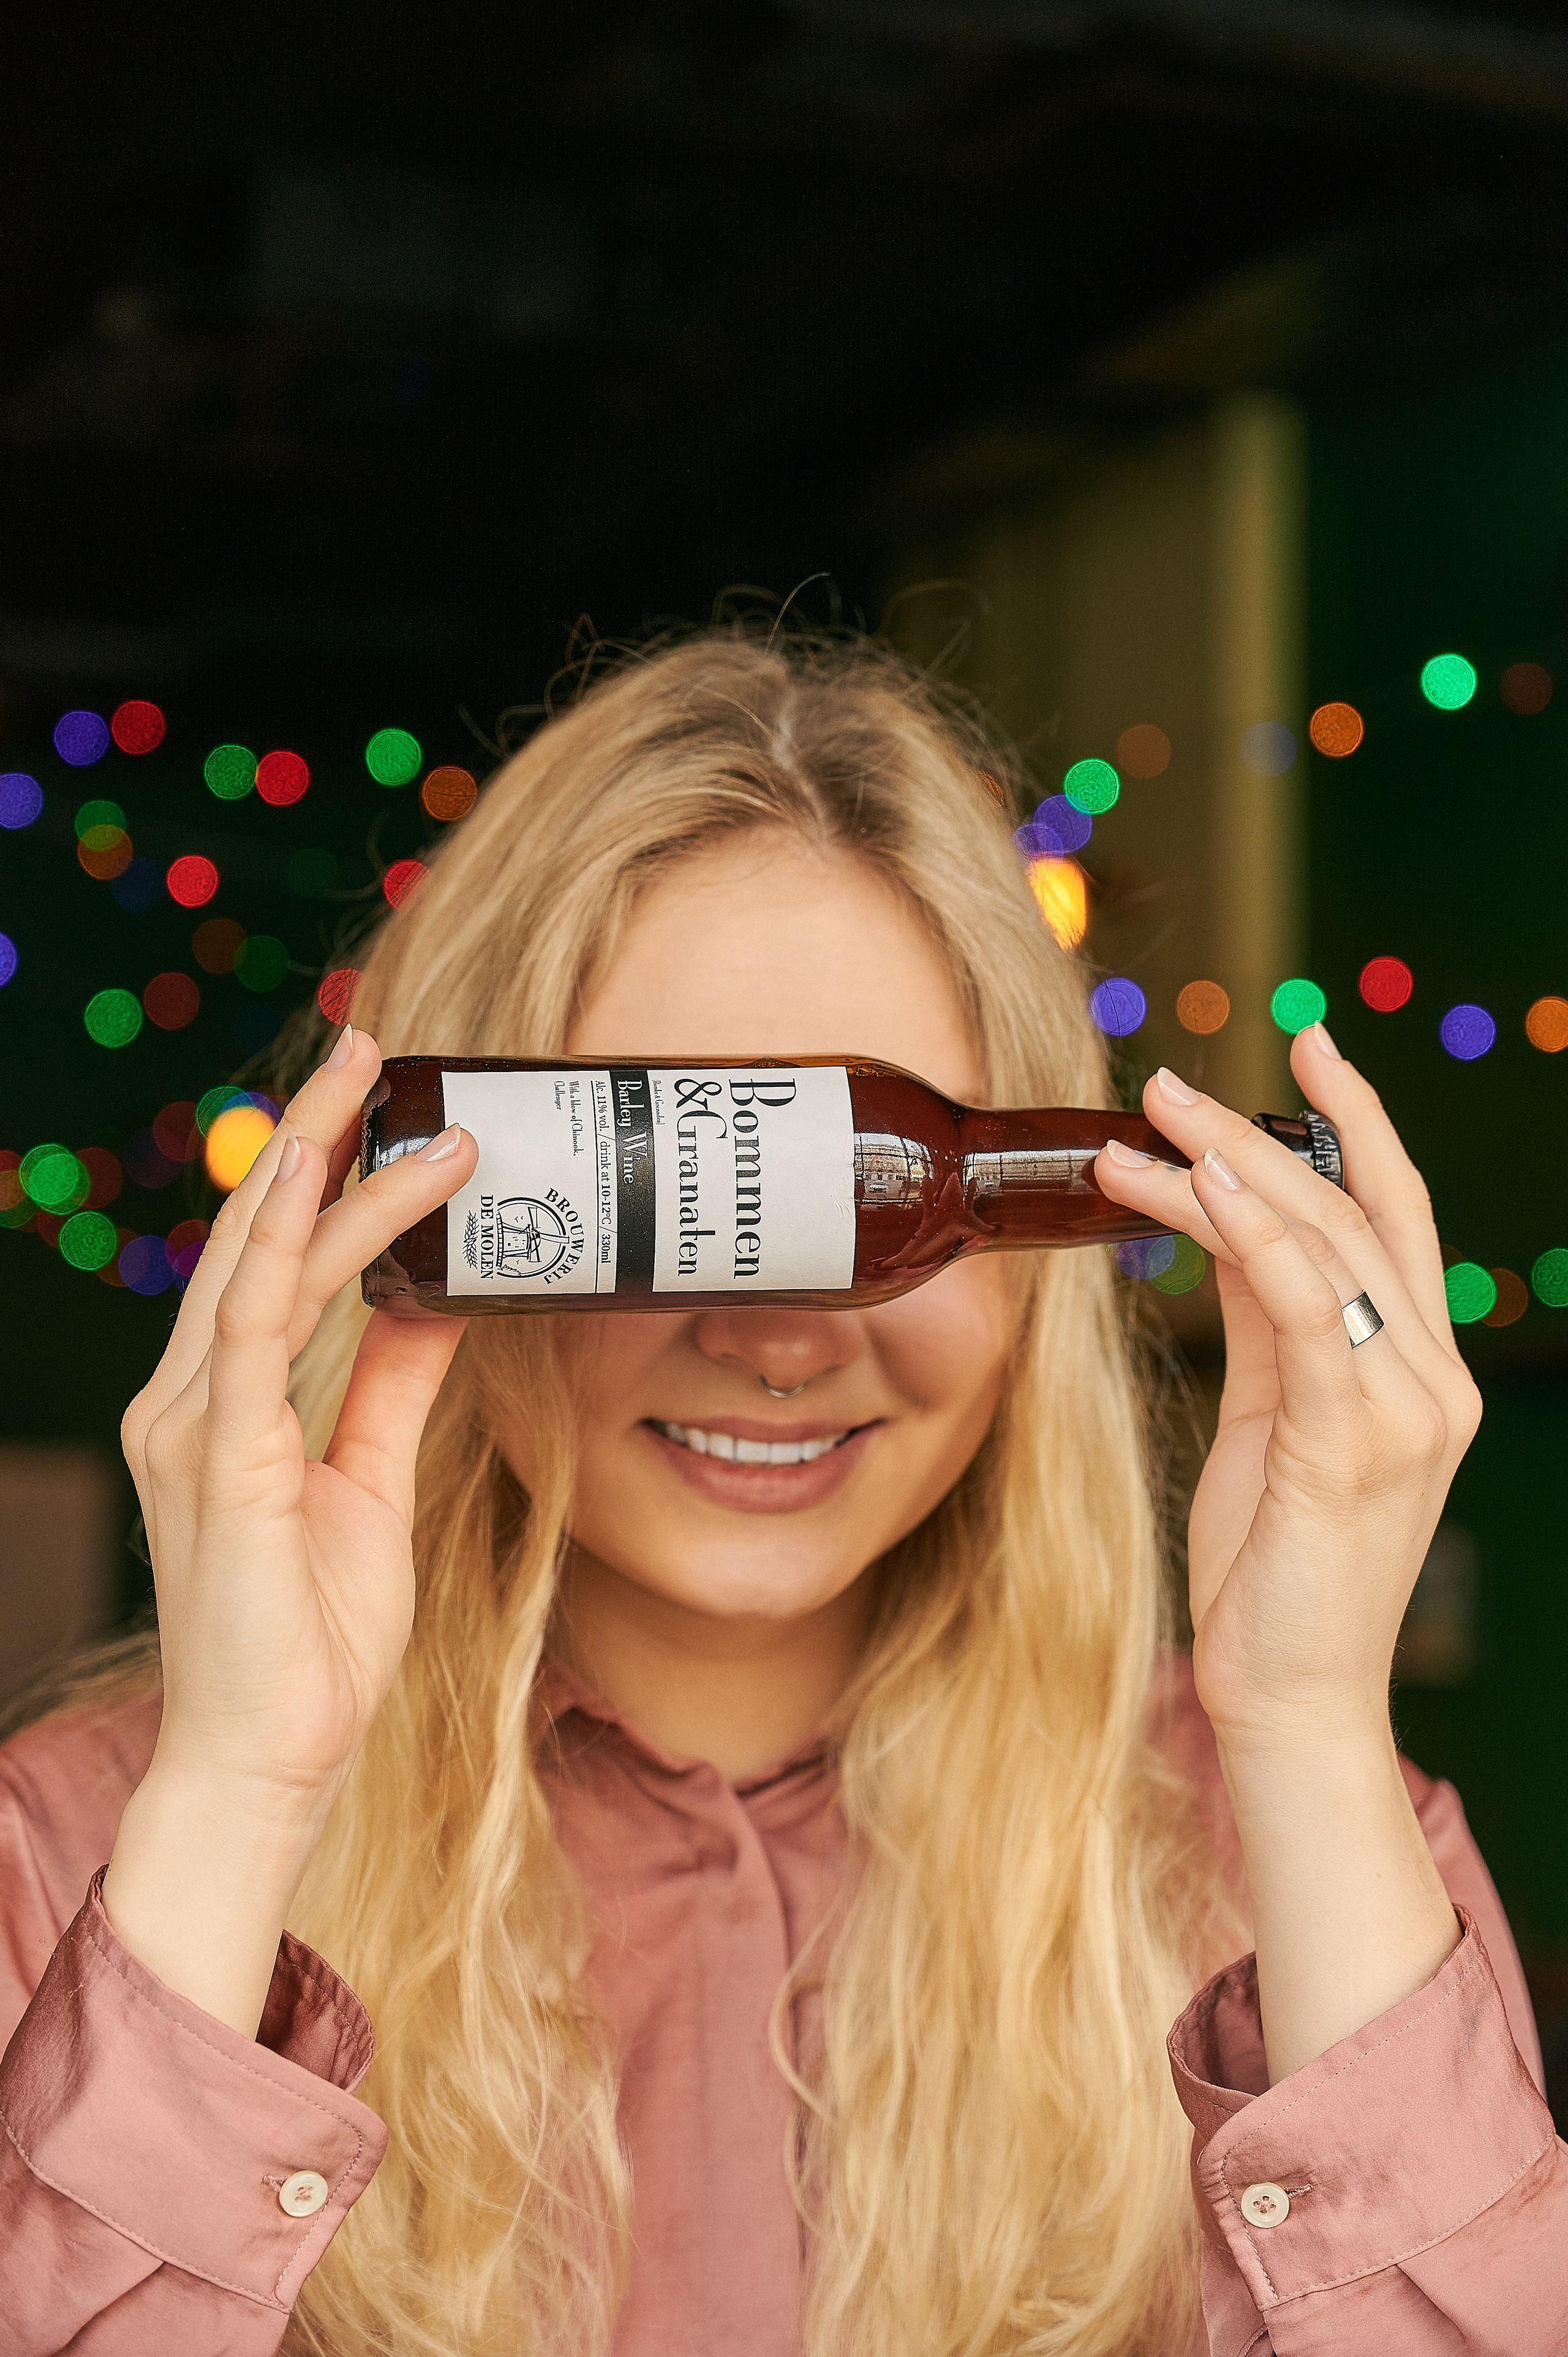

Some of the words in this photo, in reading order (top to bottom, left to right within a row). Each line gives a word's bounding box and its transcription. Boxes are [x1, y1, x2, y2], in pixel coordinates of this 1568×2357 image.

[554, 1081, 565, 1110] Challenger
[569, 1081, 580, 1095] With
[595, 1080, 606, 1094] Alc.
[571, 1099, 581, 1114] blow
[597, 1095, 608, 1113] 11%
[617, 1080, 645, 1127] Barley
[655, 1099, 665, 1126] Grenades)
[598, 1115, 609, 1132] vol.
[571, 1123, 584, 1156] Chinook,
[600, 1141, 611, 1170] drink
[622, 1131, 648, 1184] Wine
[600, 1171, 609, 1182] at
[729, 1078, 796, 1279] Bommen
[480, 1195, 494, 1219] DE
[543, 1187, 584, 1285] BROUWERIJ
[601, 1234, 611, 1263] 330ml
[480, 1224, 494, 1279] MOLEN
